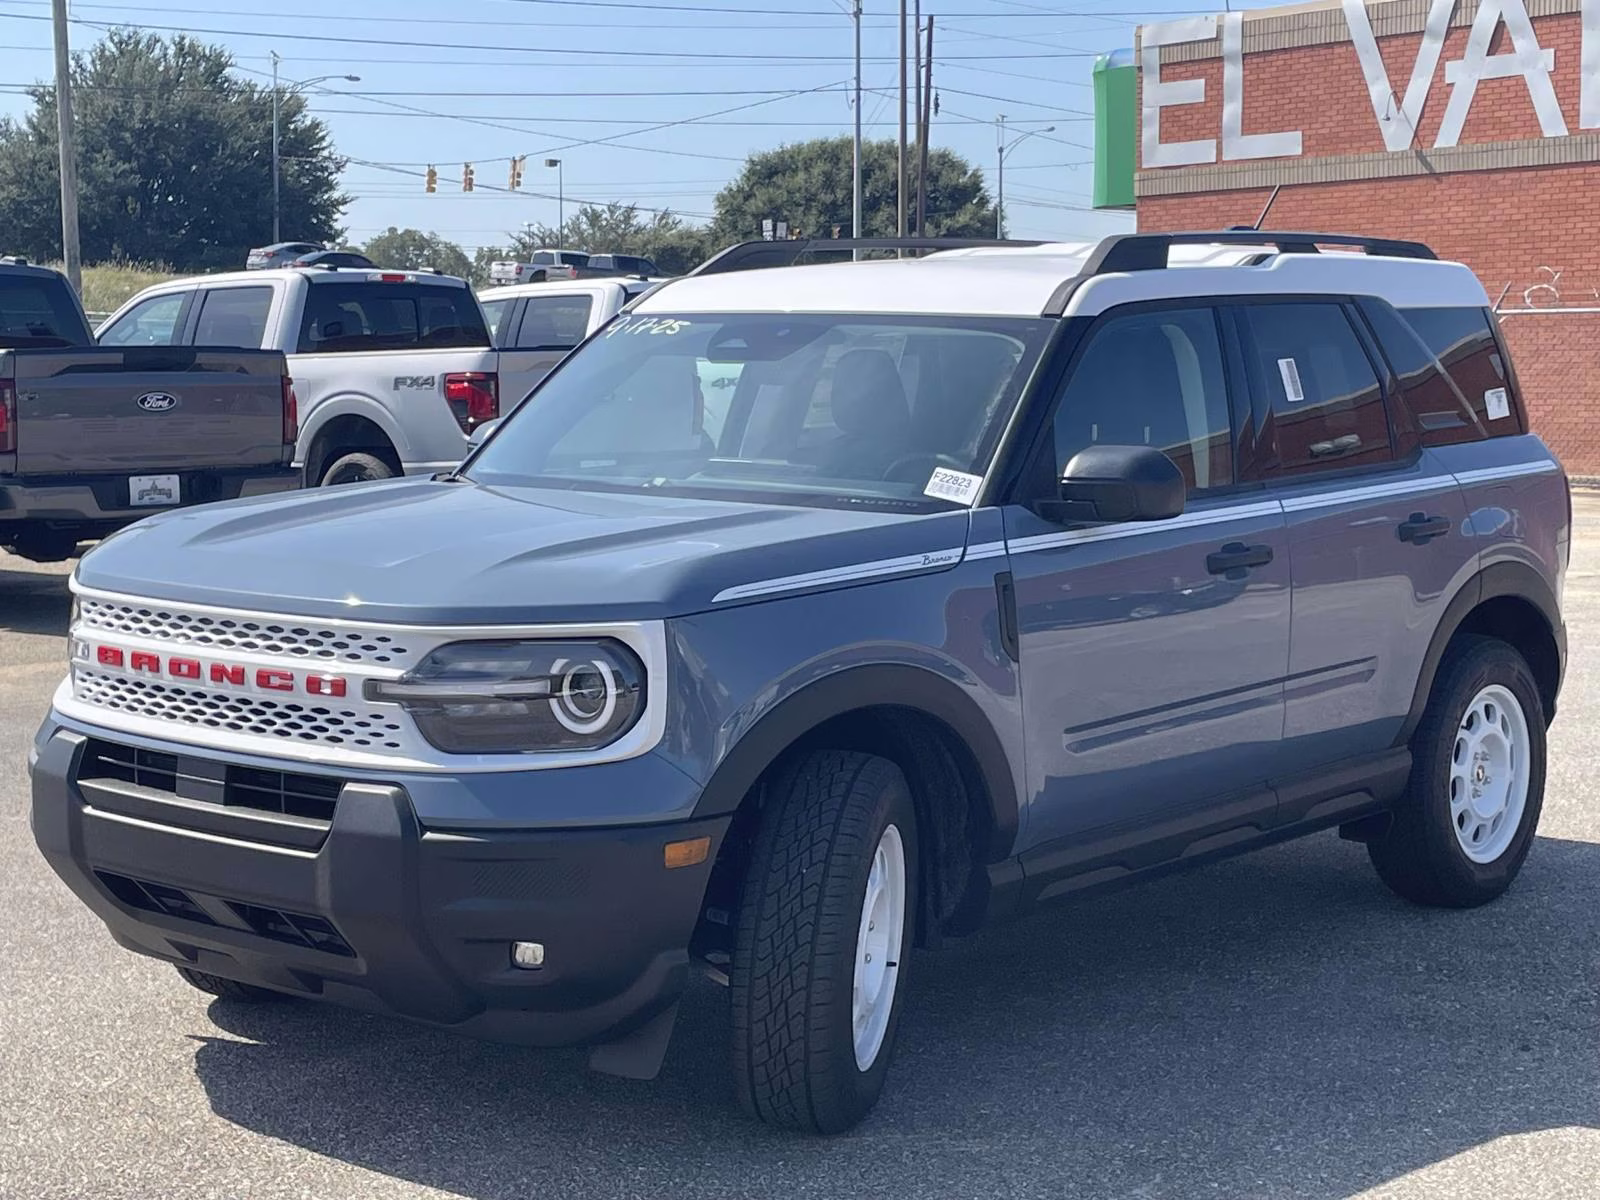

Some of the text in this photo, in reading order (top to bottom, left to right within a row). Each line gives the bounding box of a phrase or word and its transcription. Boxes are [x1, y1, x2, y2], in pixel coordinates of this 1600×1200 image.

[1141, 12, 1302, 169] EL
[393, 375, 435, 391] FX4
[142, 393, 172, 410] Ford
[933, 471, 973, 489] F22823
[97, 645, 346, 698] BRONCO
